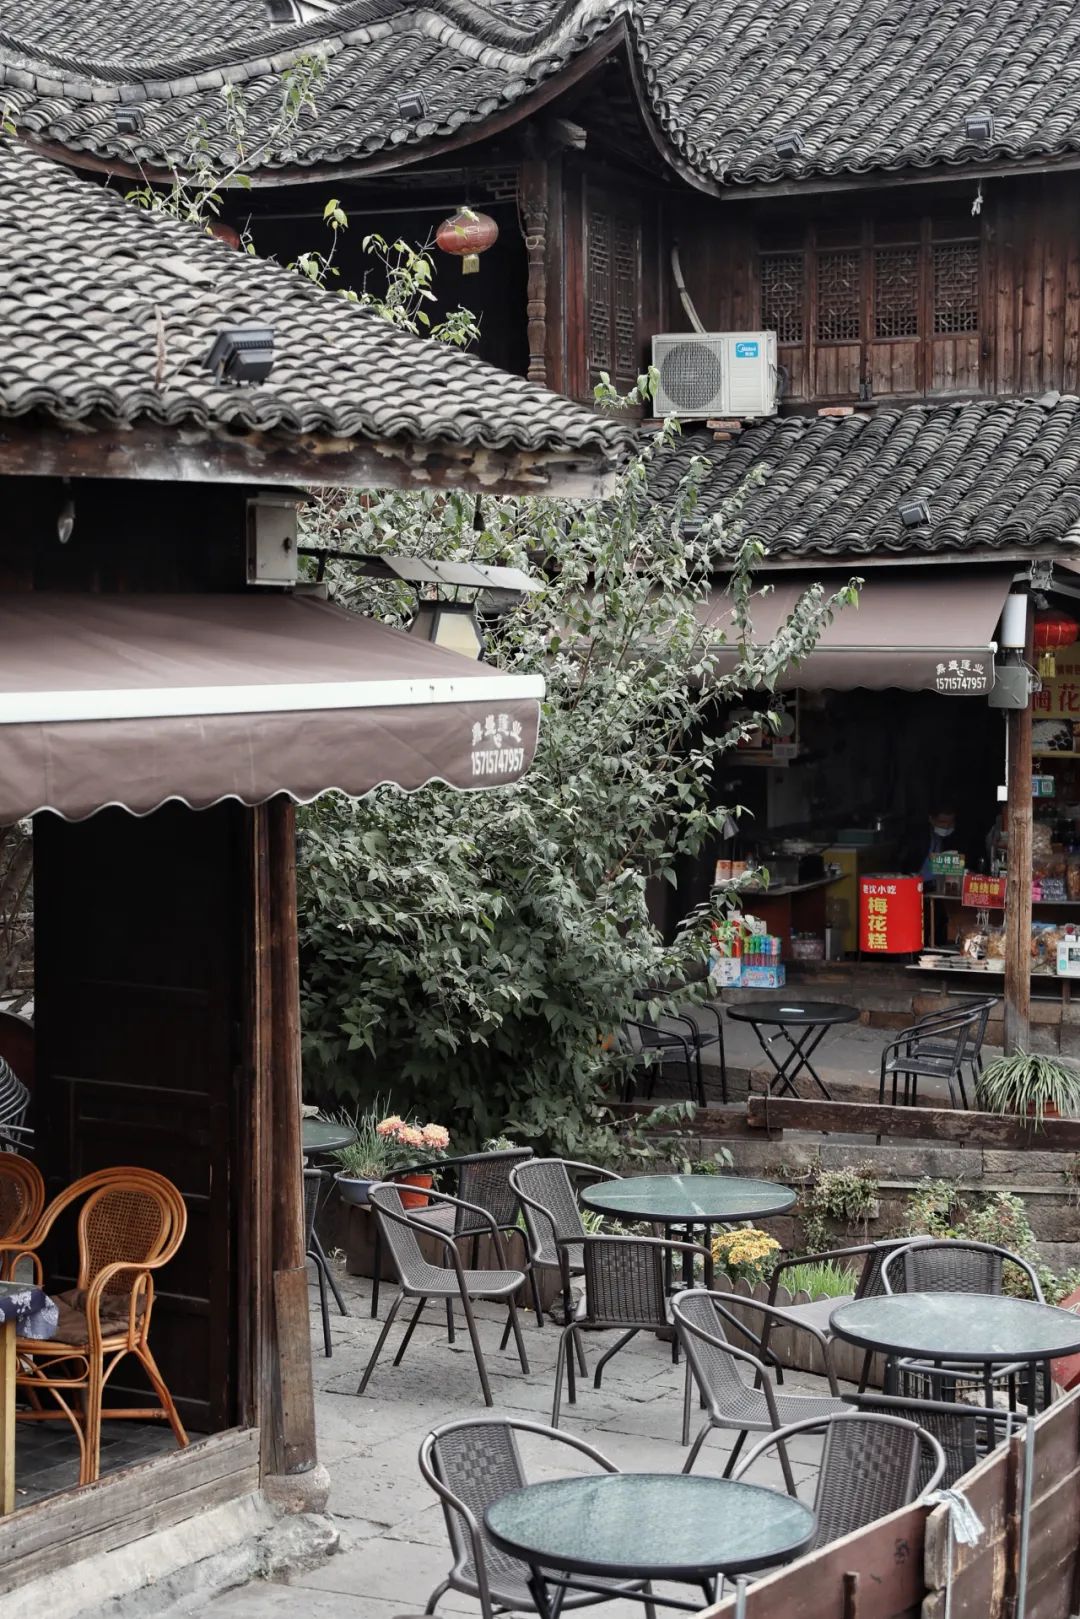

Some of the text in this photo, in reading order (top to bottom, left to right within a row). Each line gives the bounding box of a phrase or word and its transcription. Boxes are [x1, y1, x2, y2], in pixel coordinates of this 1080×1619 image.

[936, 677, 986, 690] 15715747957
[471, 748, 524, 776] 15715747957
[868, 896, 888, 950] 梅花糕
